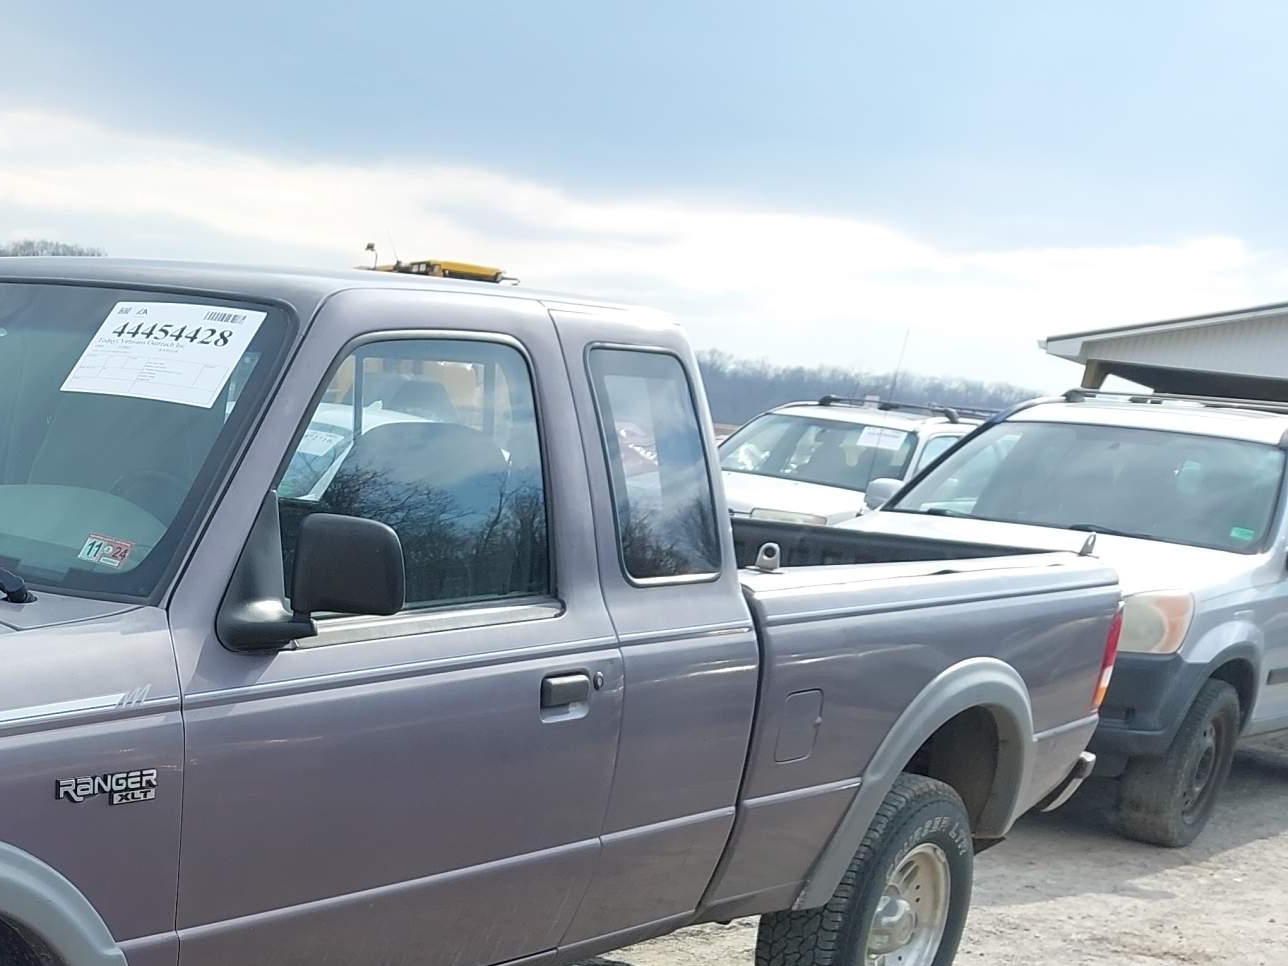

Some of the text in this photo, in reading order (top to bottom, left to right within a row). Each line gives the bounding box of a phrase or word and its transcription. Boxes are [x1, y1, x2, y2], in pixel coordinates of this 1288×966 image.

[112, 321, 234, 347] 44454428
[86, 540, 129, 561] 11 24
[58, 769, 158, 802] RANGER
[118, 789, 152, 803] XLT
